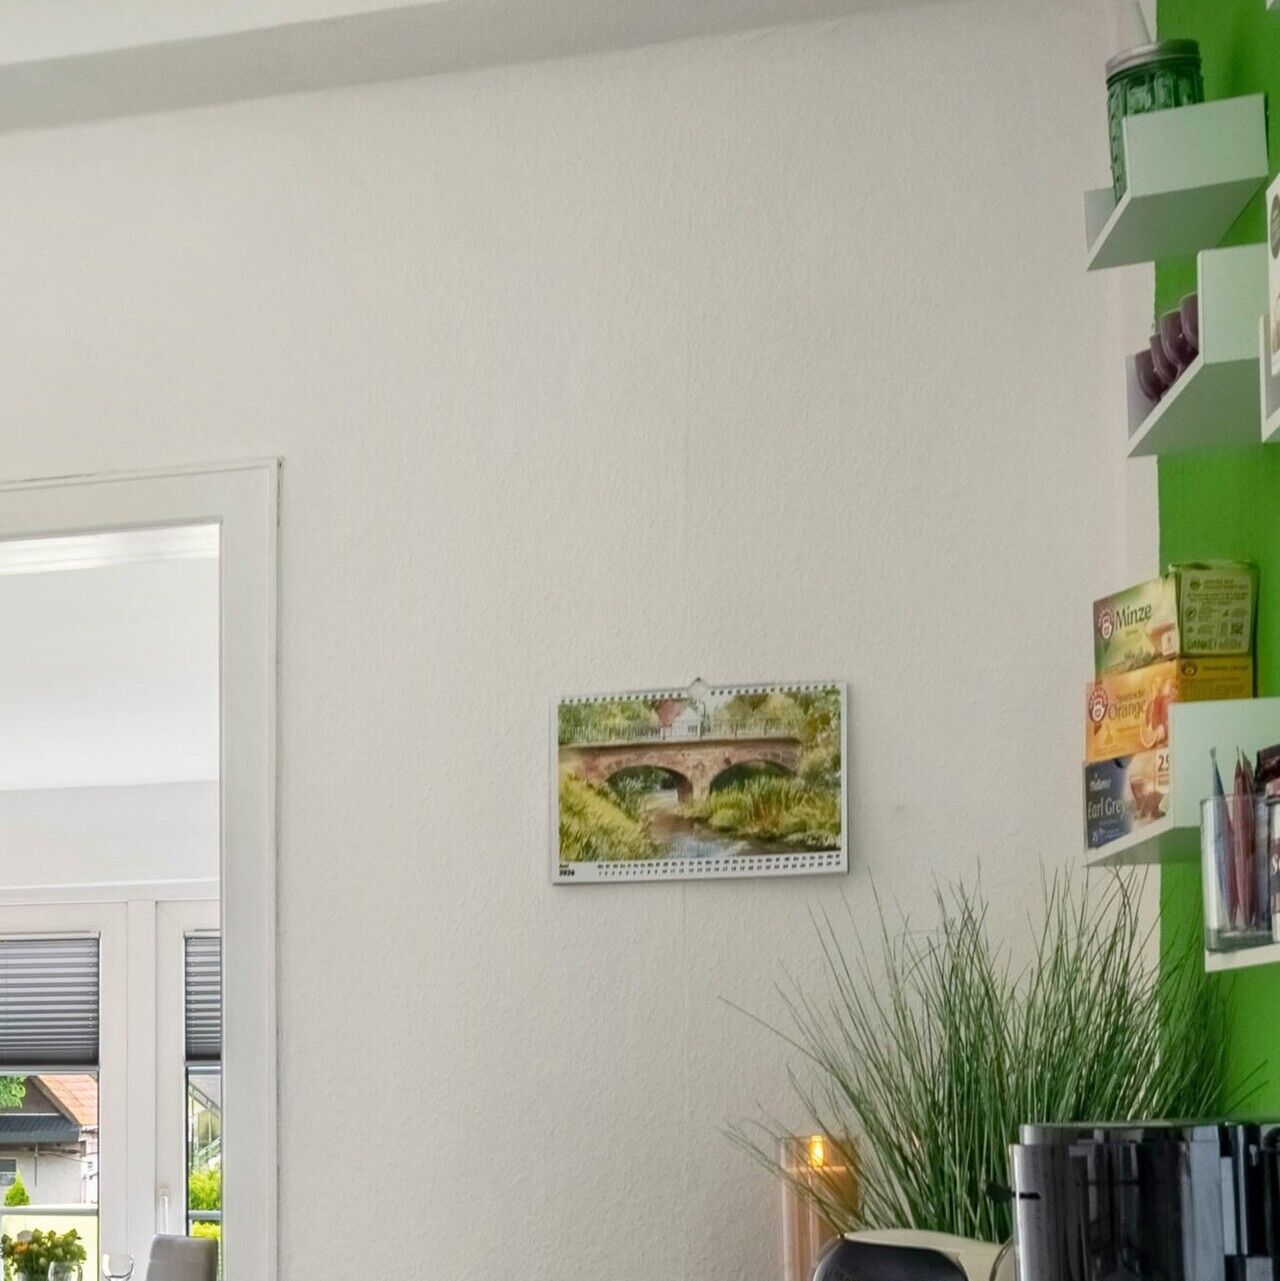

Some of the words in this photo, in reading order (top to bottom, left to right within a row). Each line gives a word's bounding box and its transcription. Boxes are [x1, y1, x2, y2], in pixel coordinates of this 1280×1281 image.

[1115, 603, 1153, 630] Minze
[1108, 699, 1146, 721] Orange
[1088, 798, 1104, 820] Earl
[1105, 797, 1127, 819] Grey
